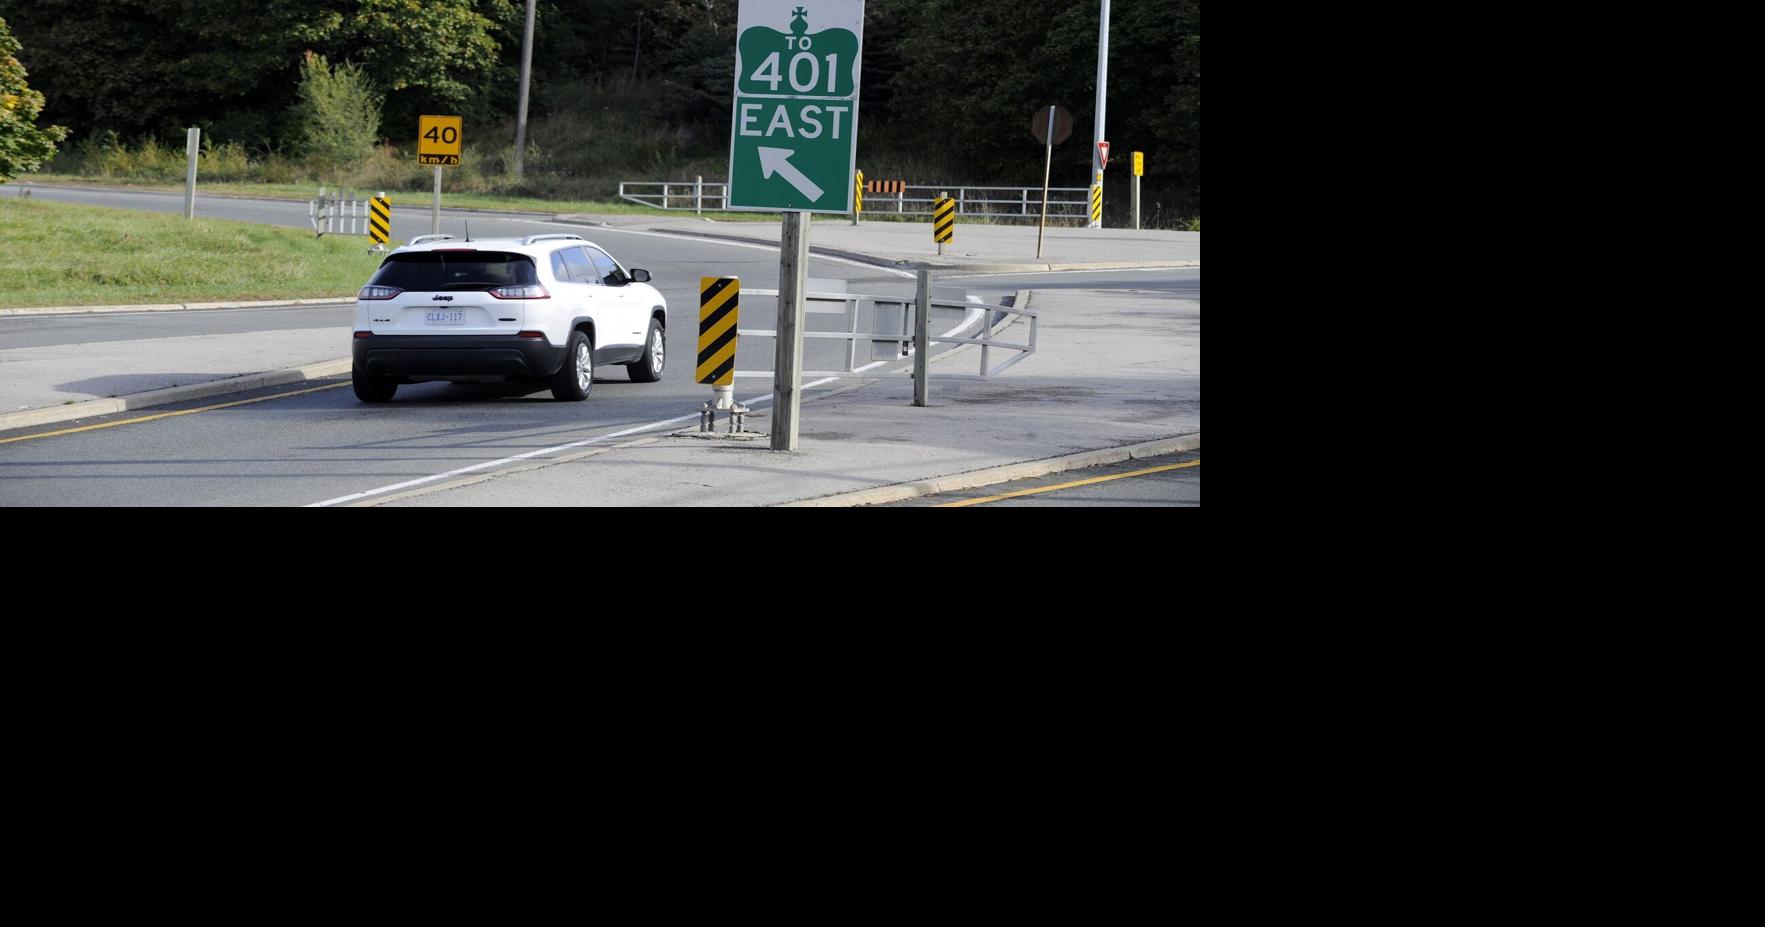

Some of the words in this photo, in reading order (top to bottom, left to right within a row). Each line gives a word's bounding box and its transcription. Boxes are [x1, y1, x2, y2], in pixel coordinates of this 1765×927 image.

[785, 36, 812, 50] TO
[750, 51, 838, 93] 401
[740, 103, 849, 139] EAST
[423, 126, 458, 144] 40
[420, 155, 458, 164] km/h
[432, 294, 454, 302] Jeep
